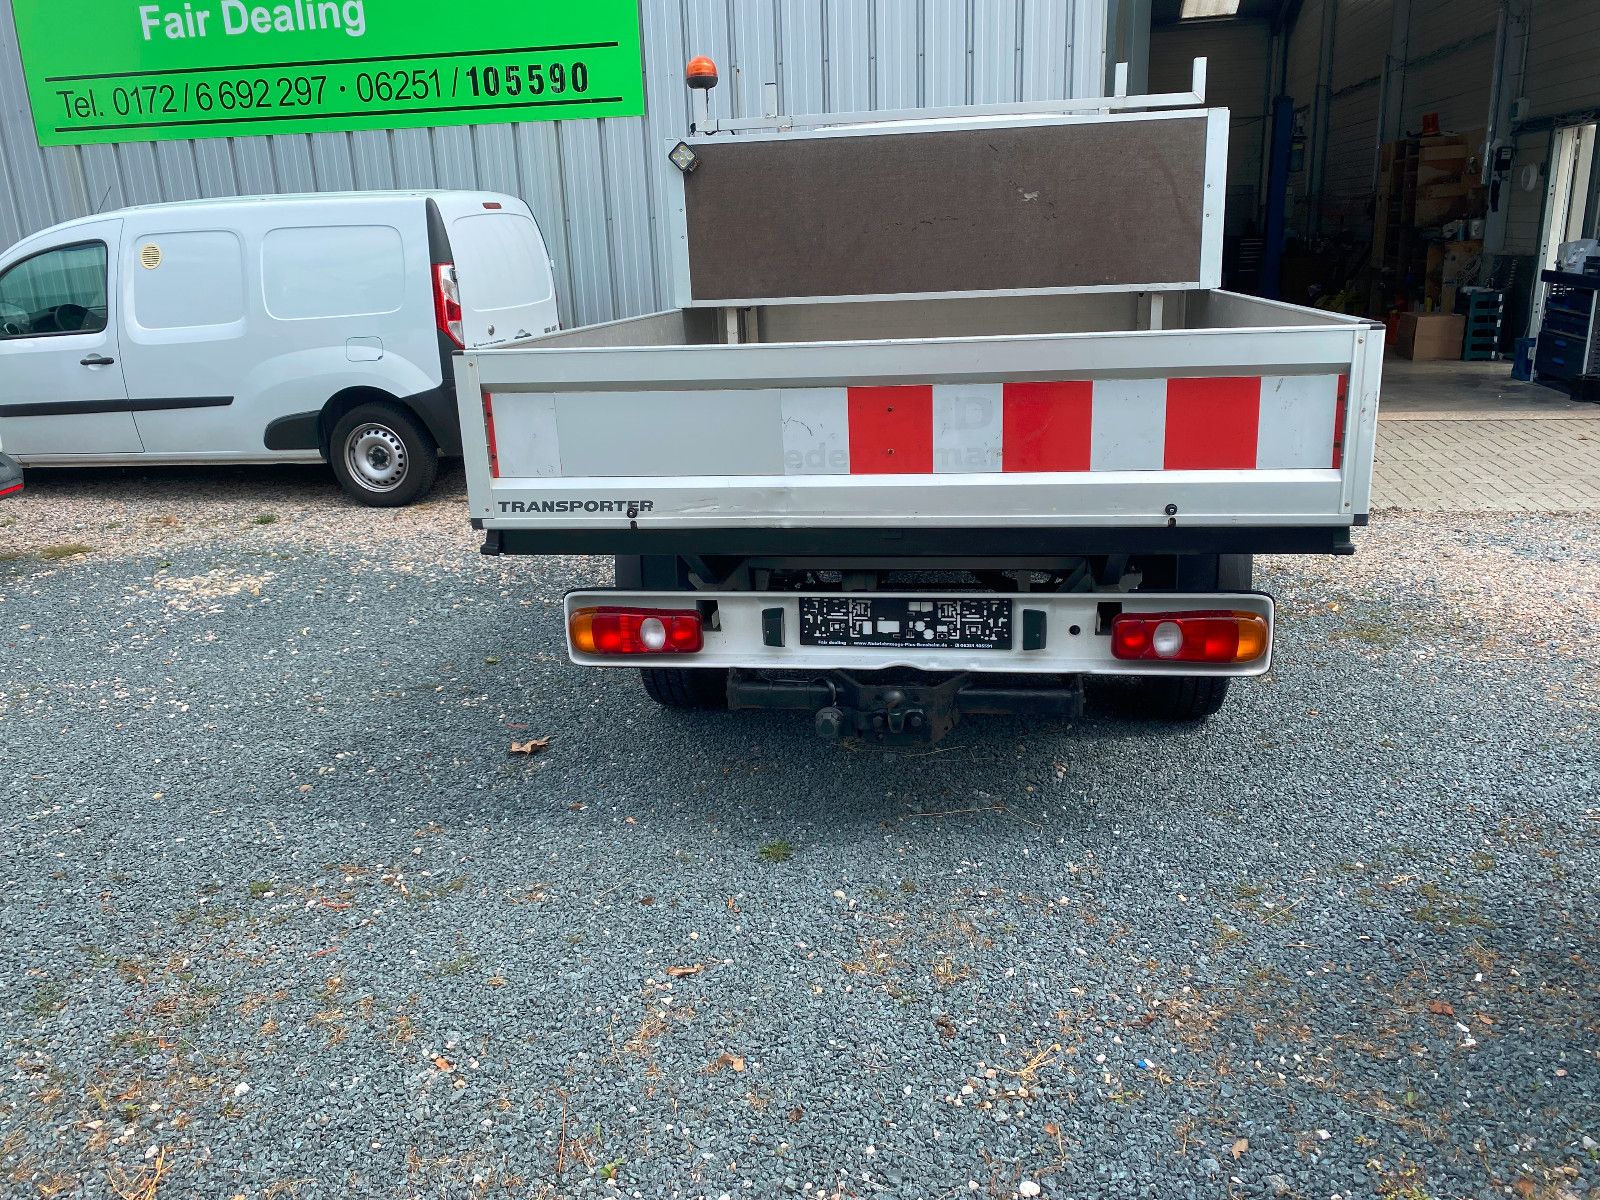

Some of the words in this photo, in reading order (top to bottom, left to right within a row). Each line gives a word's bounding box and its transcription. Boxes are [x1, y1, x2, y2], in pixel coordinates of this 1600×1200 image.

[139, 3, 210, 41] Fair
[220, 0, 366, 37] Dealing
[55, 88, 104, 118] Tel.
[497, 500, 654, 513] TRANSPORTER
